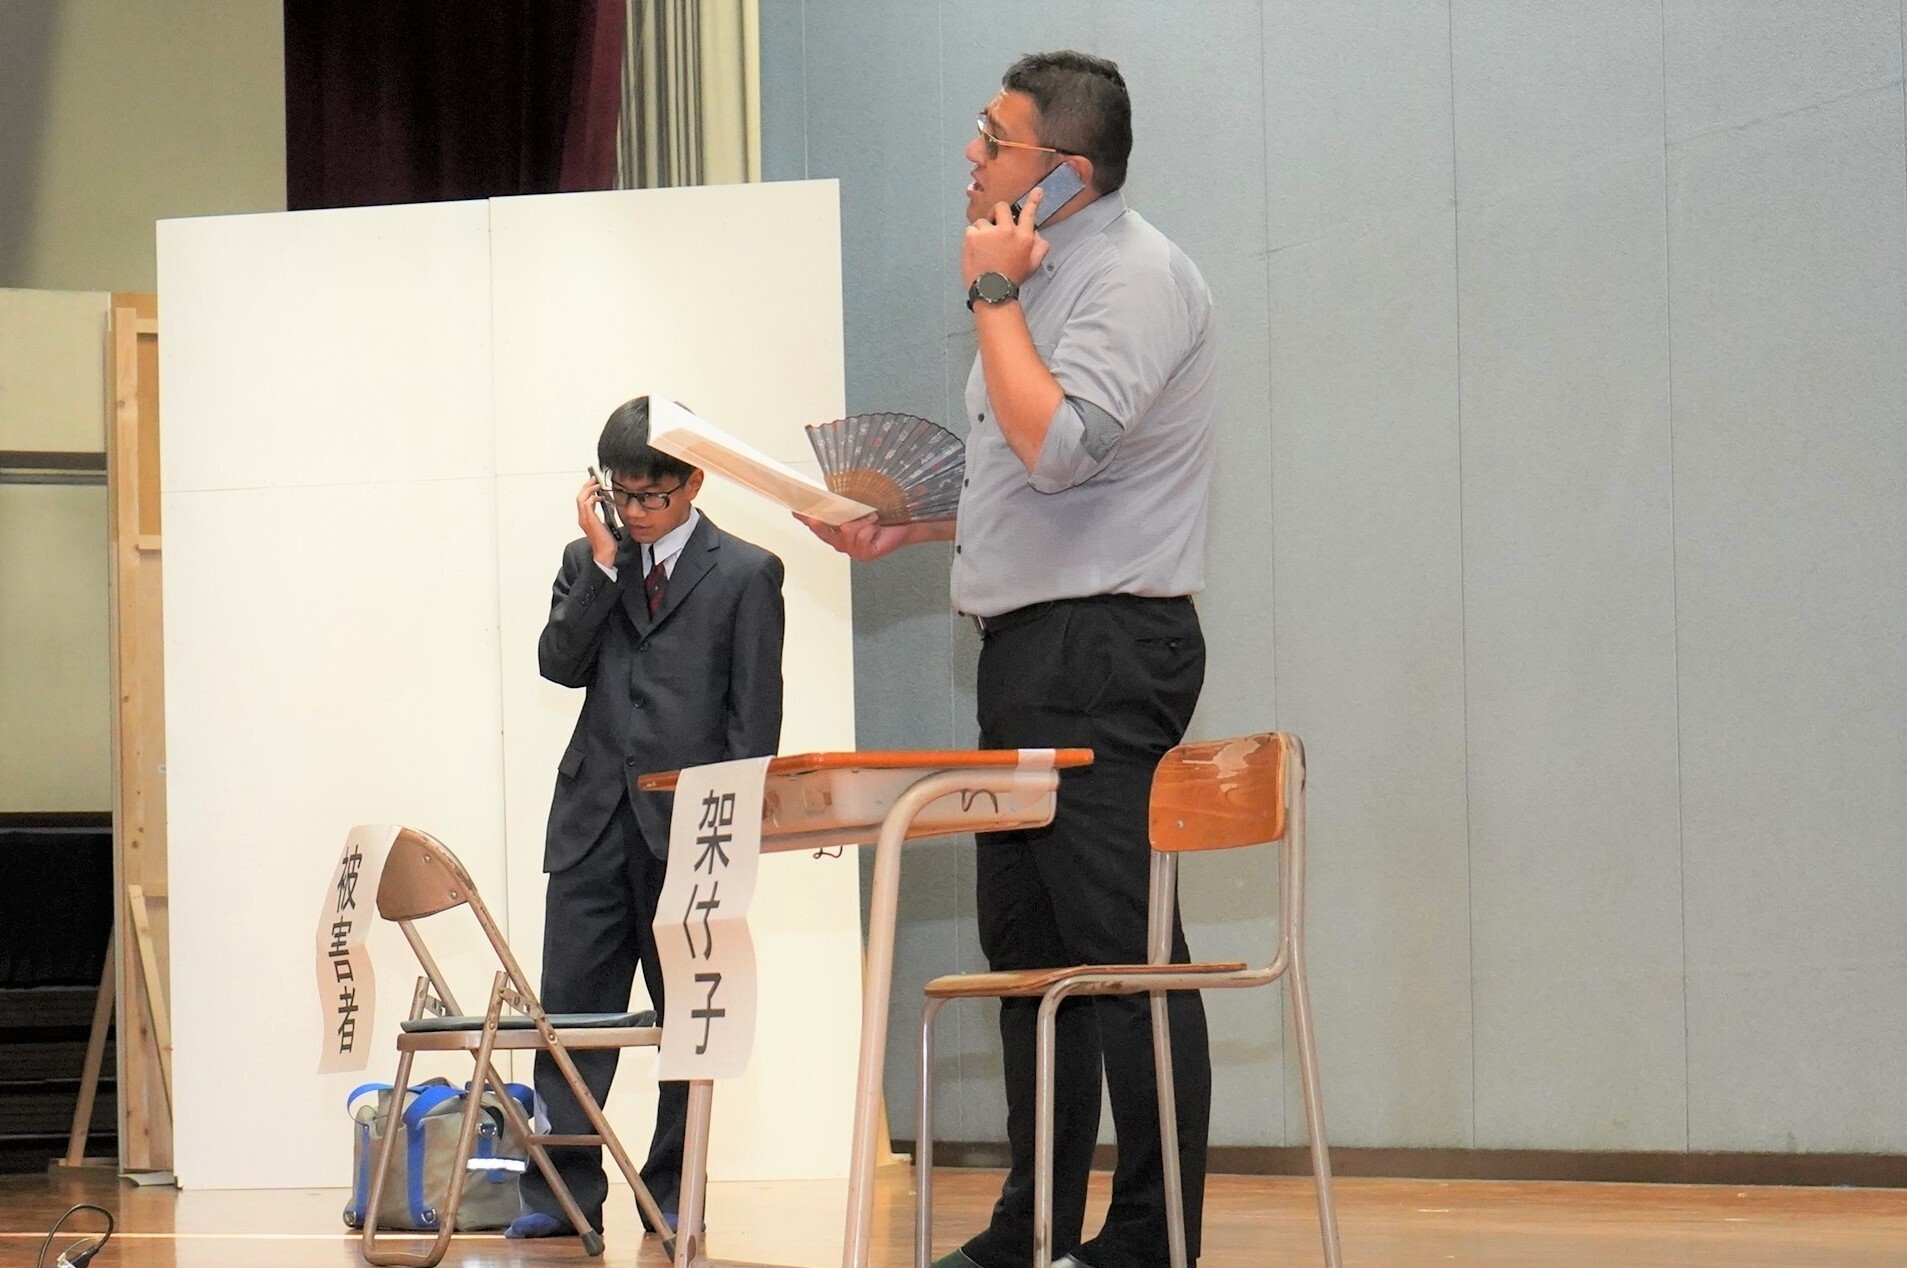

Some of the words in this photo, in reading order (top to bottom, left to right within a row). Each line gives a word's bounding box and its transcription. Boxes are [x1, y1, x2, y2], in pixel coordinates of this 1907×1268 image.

[328, 843, 363, 1055] 被害者
[683, 789, 736, 1055] 架け子
